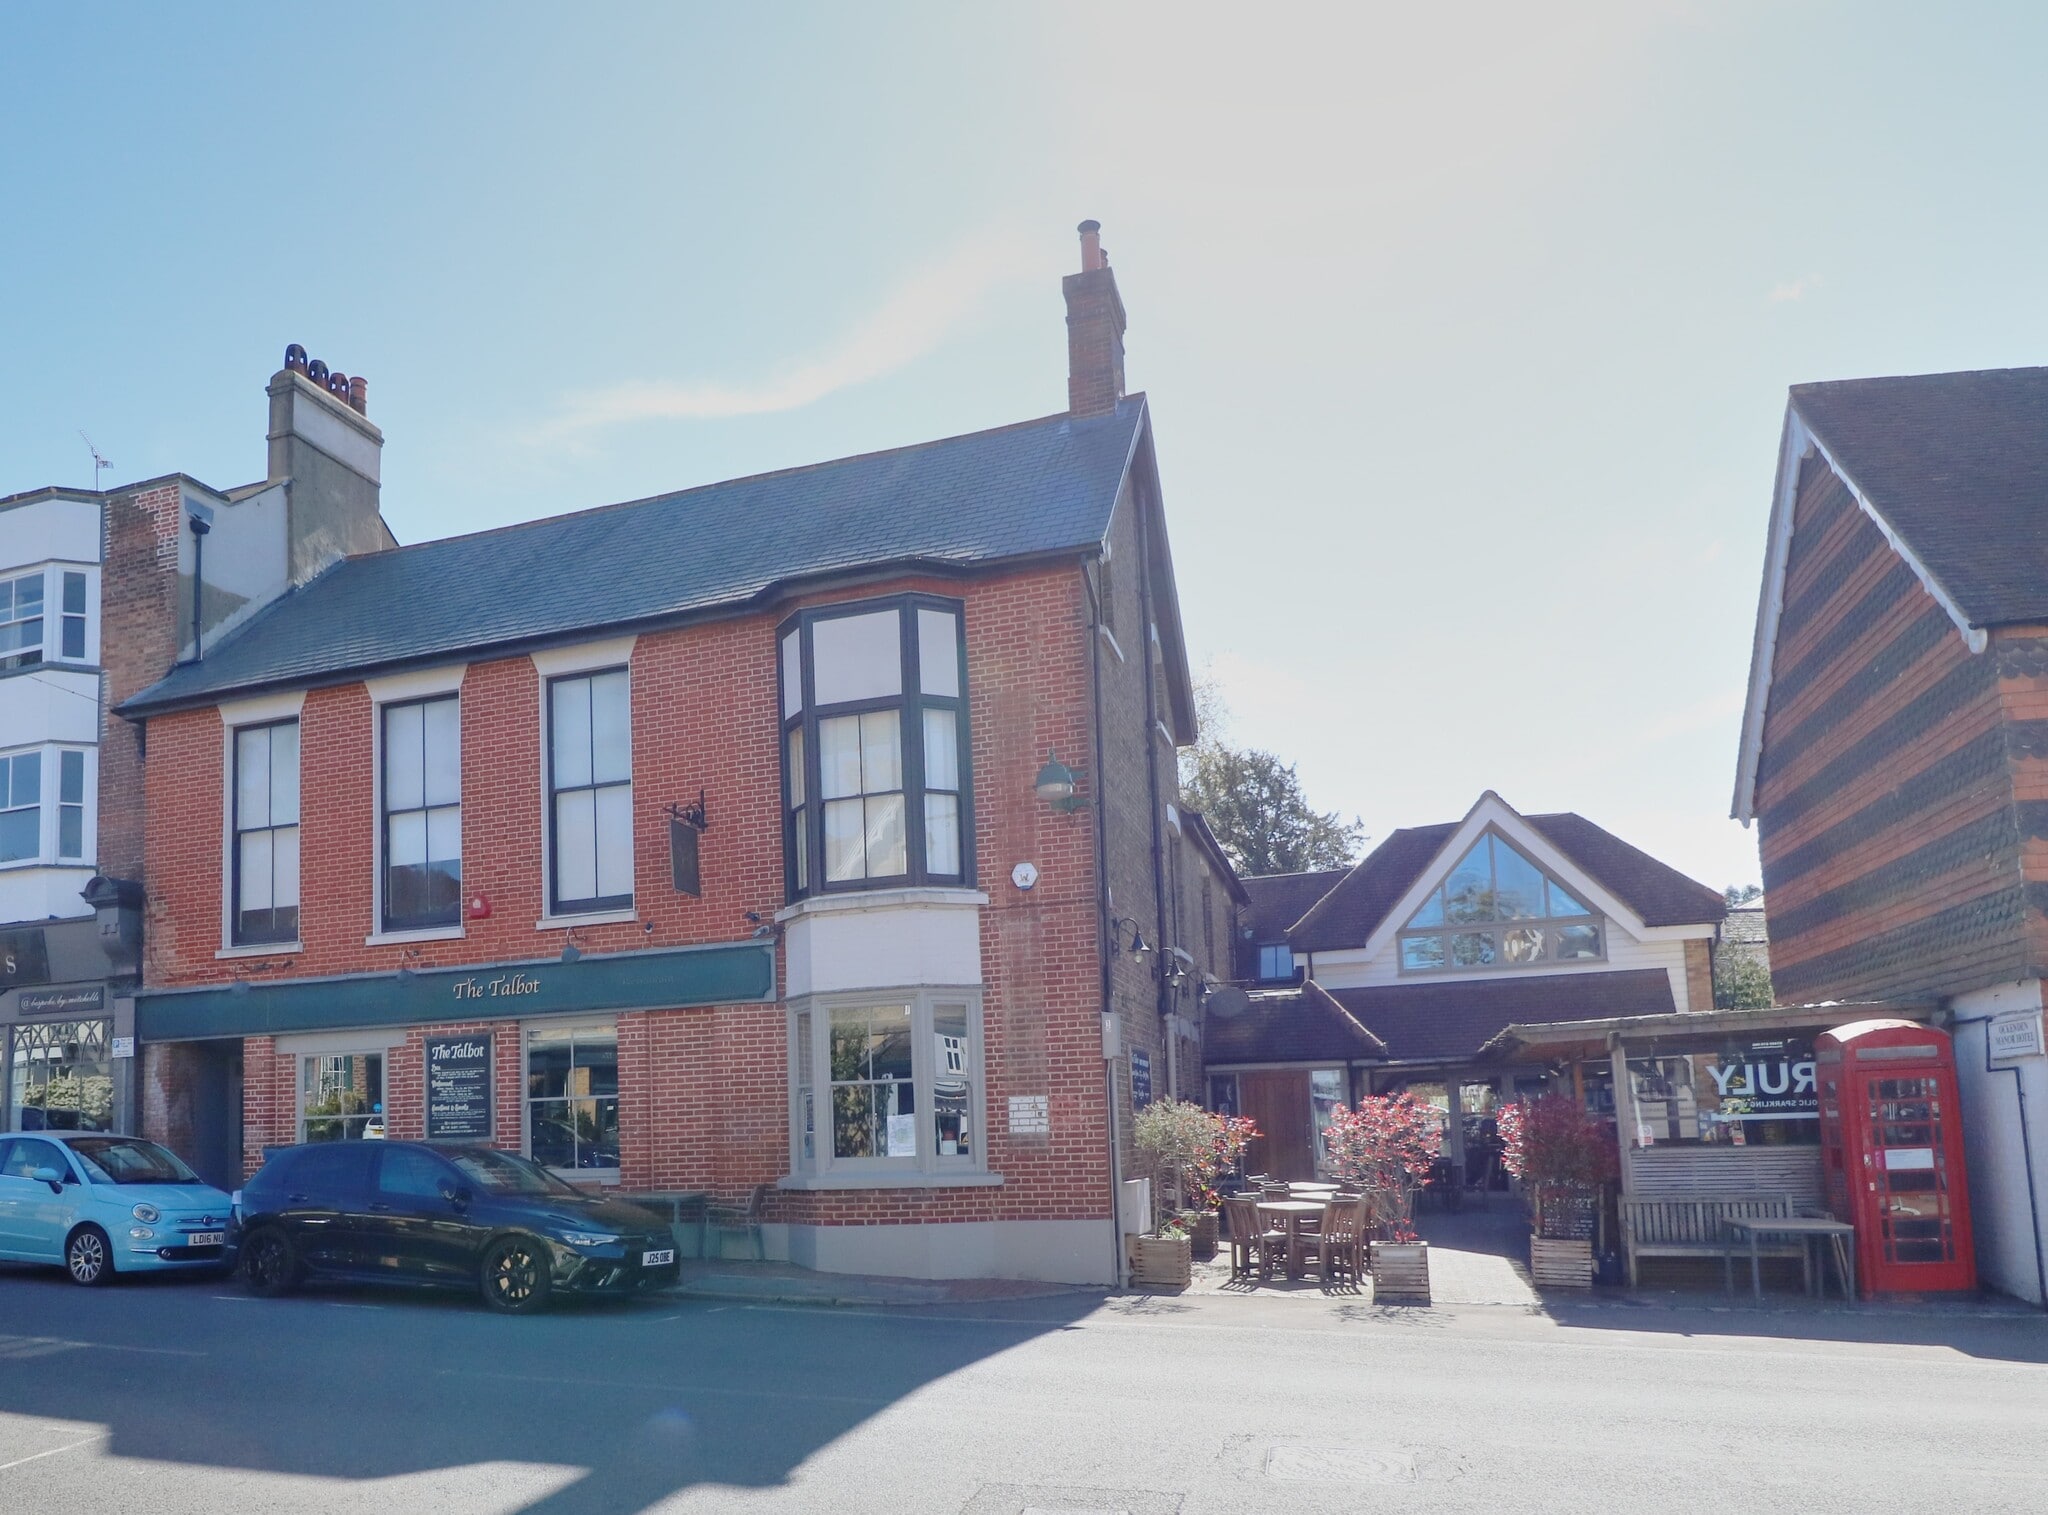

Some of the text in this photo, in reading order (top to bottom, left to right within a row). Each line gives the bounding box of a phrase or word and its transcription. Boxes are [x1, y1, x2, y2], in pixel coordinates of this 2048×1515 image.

[453, 974, 541, 999] The Talbot
[432, 1042, 485, 1060] The Talbot
[193, 1233, 224, 1244] LD16 NU
